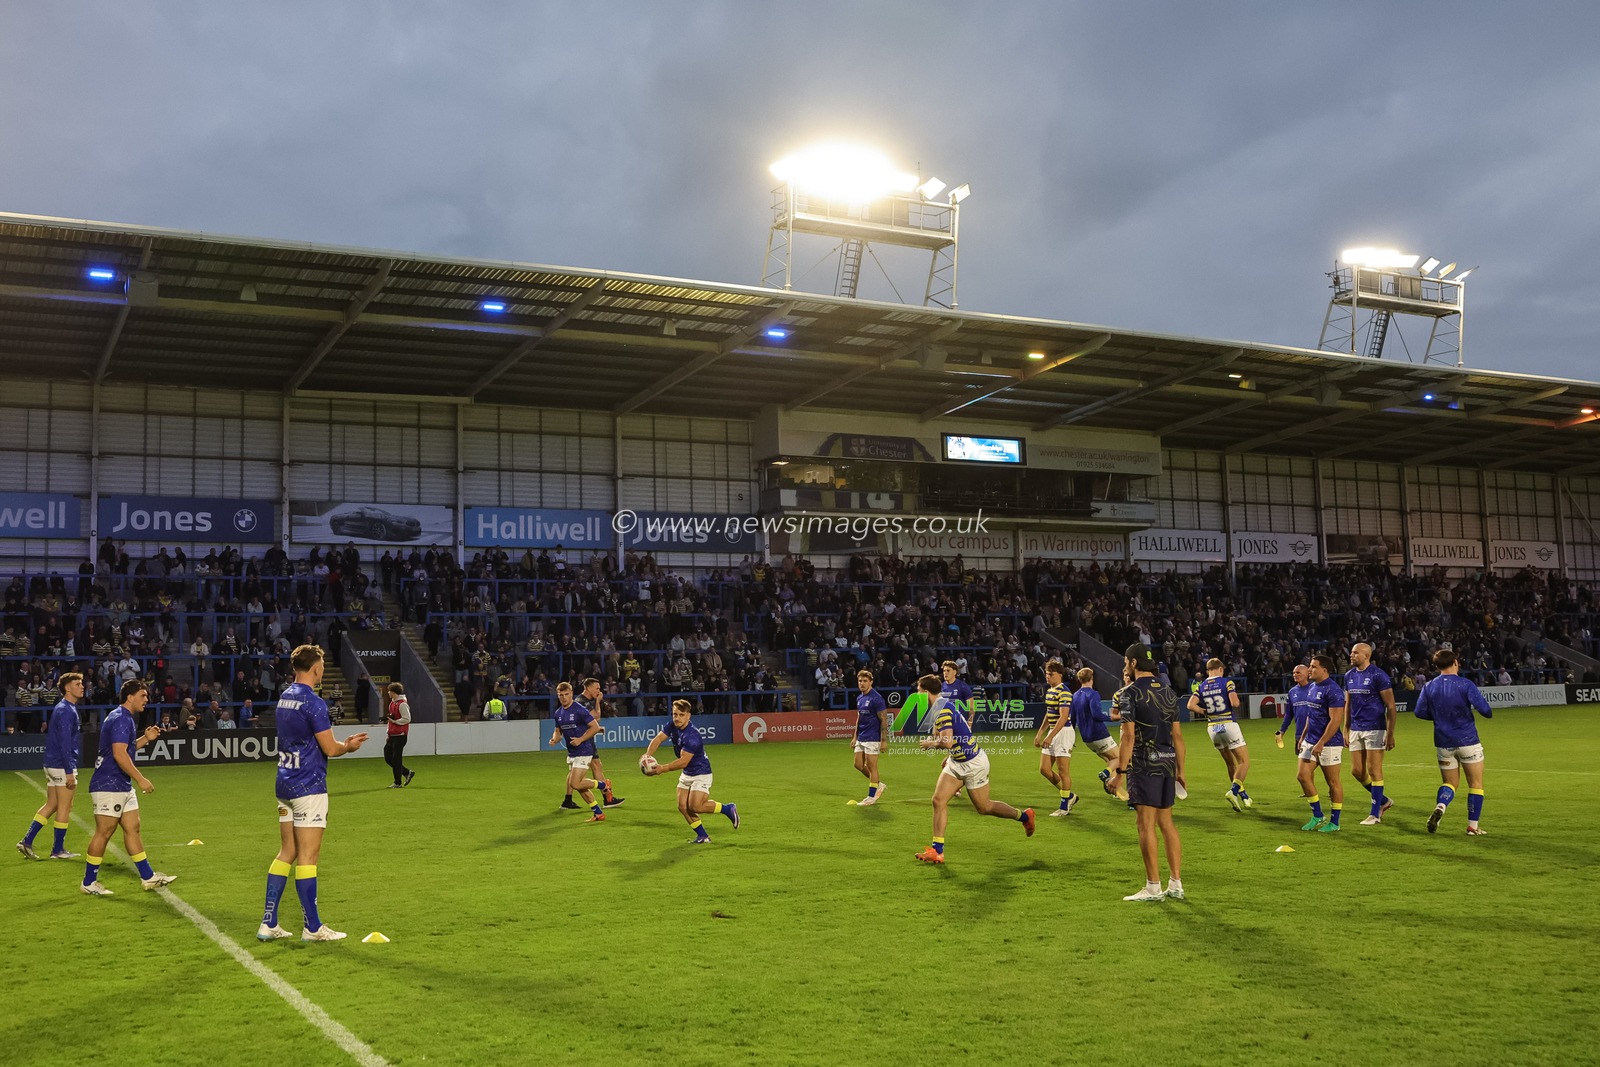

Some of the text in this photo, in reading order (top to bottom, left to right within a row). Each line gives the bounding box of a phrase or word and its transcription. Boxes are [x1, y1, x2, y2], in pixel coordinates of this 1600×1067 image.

[869, 446, 907, 459] Chester
[0, 501, 66, 529] well
[112, 502, 213, 533] Jones
[477, 513, 600, 541] Halliwell
[632, 517, 709, 544] Jones
[907, 531, 1009, 552] Your campus
[1026, 535, 1122, 556] in Warrington
[1138, 536, 1221, 553] HALLIWELL
[1238, 539, 1278, 557] JONES
[1413, 544, 1479, 559] HALLIWELL
[1493, 546, 1526, 562] JONES
[1203, 695, 1227, 713] 33
[1484, 687, 1563, 703] atsons Solicitors
[825, 717, 846, 725] Tackling
[999, 706, 1034, 731] HOOVER
[771, 724, 813, 733] OVERFORD
[825, 724, 856, 732] Construction
[0, 745, 47, 754] NG SERVICE
[135, 736, 279, 761] EAT UNIQU
